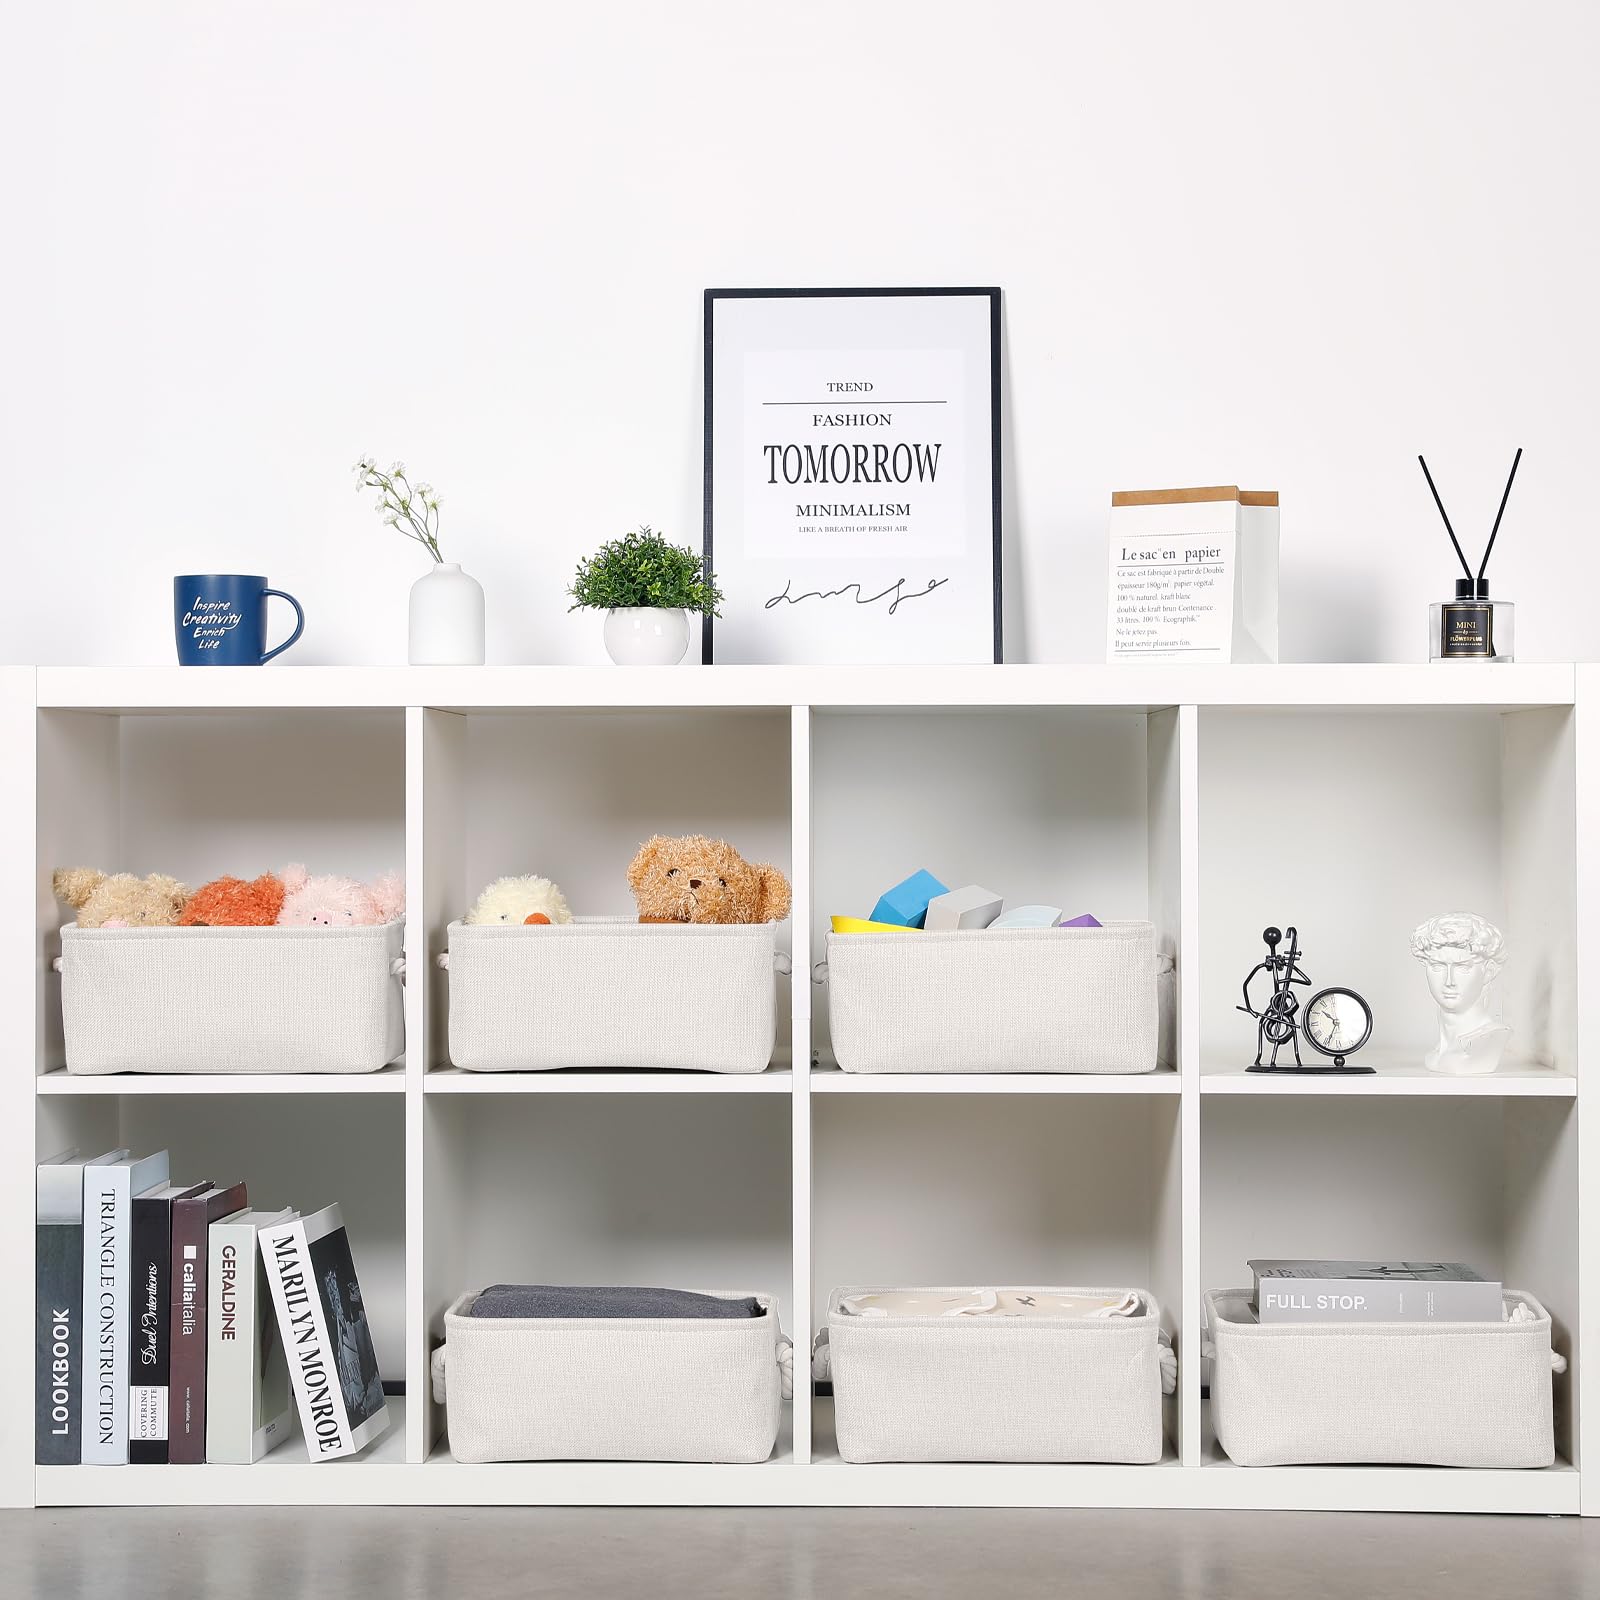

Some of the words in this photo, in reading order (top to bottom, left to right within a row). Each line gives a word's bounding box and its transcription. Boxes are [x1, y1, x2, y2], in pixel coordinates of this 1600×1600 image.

[826, 382, 874, 393] TREND
[812, 413, 893, 427] FASHION
[763, 443, 942, 485] TOMORROW
[795, 503, 911, 517] MINIMALISM
[1121, 547, 1138, 561] Le
[1162, 549, 1176, 560] en
[1184, 546, 1221, 563] papier
[182, 611, 242, 630] Creativity
[192, 596, 231, 614] Inspire
[1455, 621, 1476, 629] MINI
[193, 626, 226, 639] Enrich
[99, 1188, 117, 1289] TRIANGLE
[141, 1261, 158, 1327] Intentions
[182, 1262, 197, 1337] caliaitalia
[221, 1244, 237, 1342] GERALDINE
[1265, 1294, 1312, 1310] FULL
[1316, 1294, 1368, 1311] STOP.
[140, 1327, 158, 1366] Duel
[271, 1233, 319, 1345] MARILYN
[298, 1346, 343, 1453] MONROE
[51, 1307, 71, 1436] LOOKBOOK
[98, 1293, 116, 1446] CONSTRUCTION
[140, 1388, 148, 1438] COVERING
[149, 1388, 157, 1437] COMMUTE
